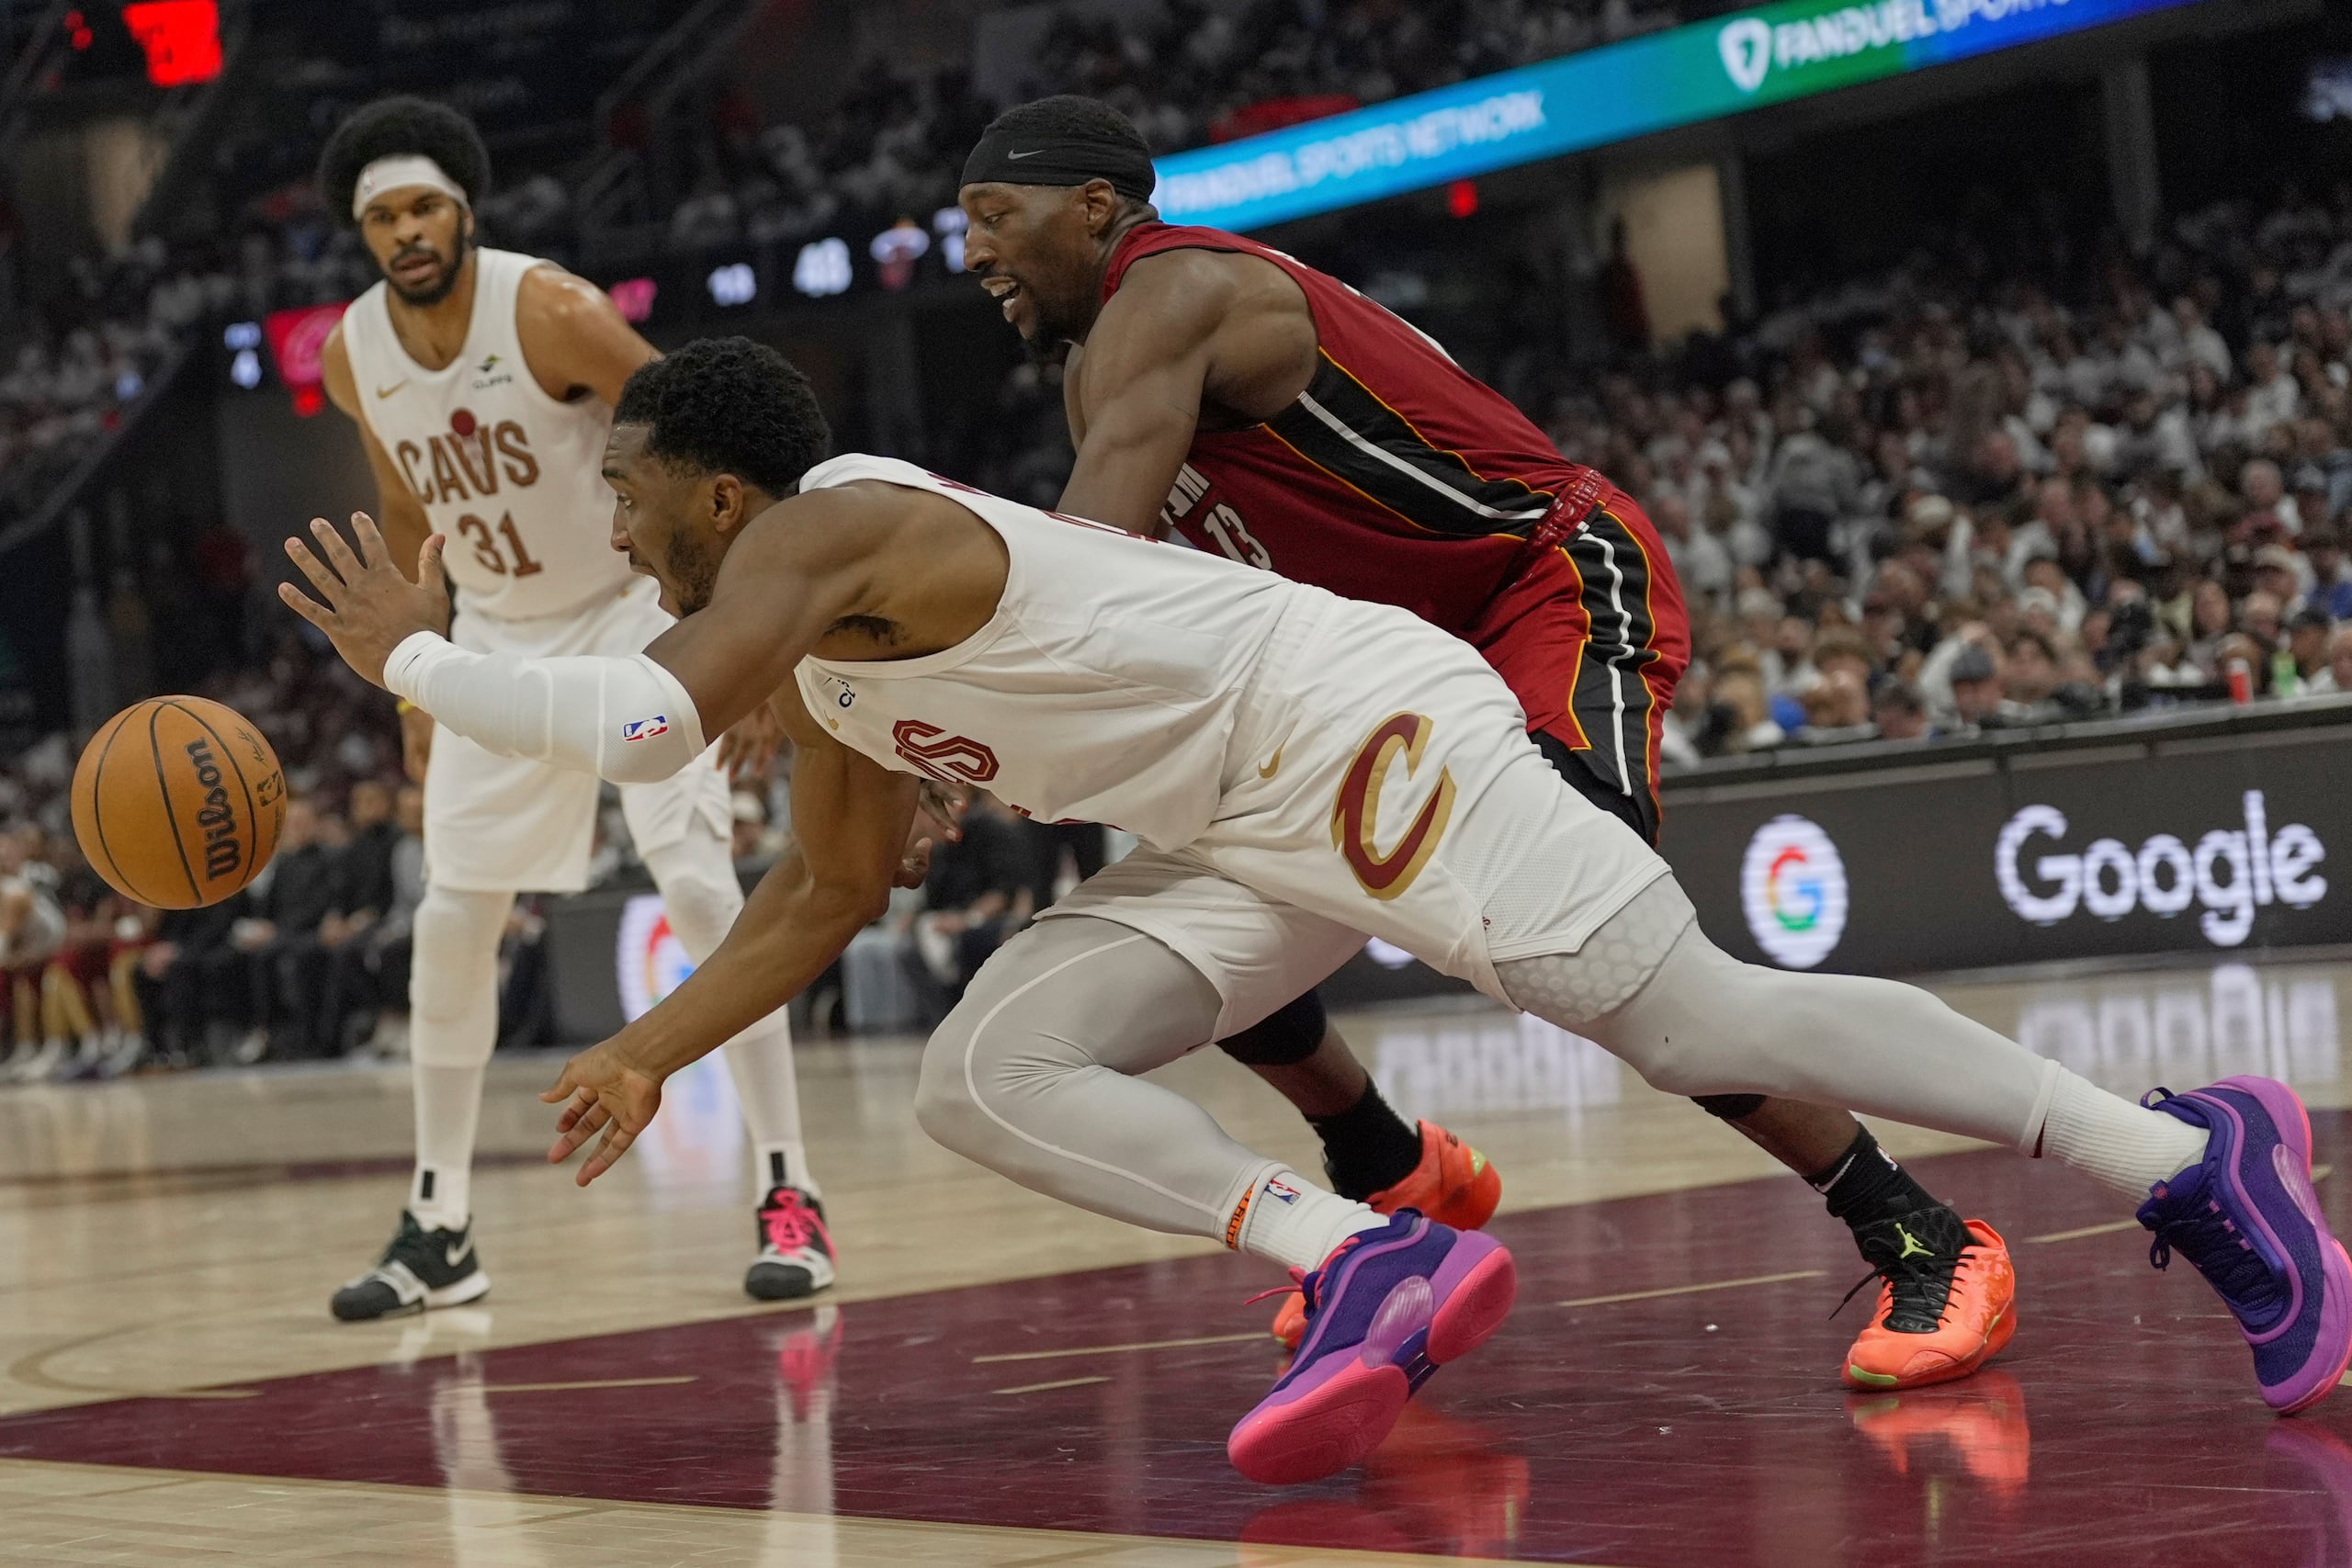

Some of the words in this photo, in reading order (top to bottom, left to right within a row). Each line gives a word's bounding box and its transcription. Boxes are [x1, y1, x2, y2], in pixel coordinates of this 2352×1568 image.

[1773, 0, 1937, 70] FANDUEL
[397, 420, 540, 504] CAVS
[458, 510, 544, 577] 31
[1204, 502, 1272, 570] 13
[186, 737, 241, 882] Wilson
[1995, 789, 2328, 946] Google
